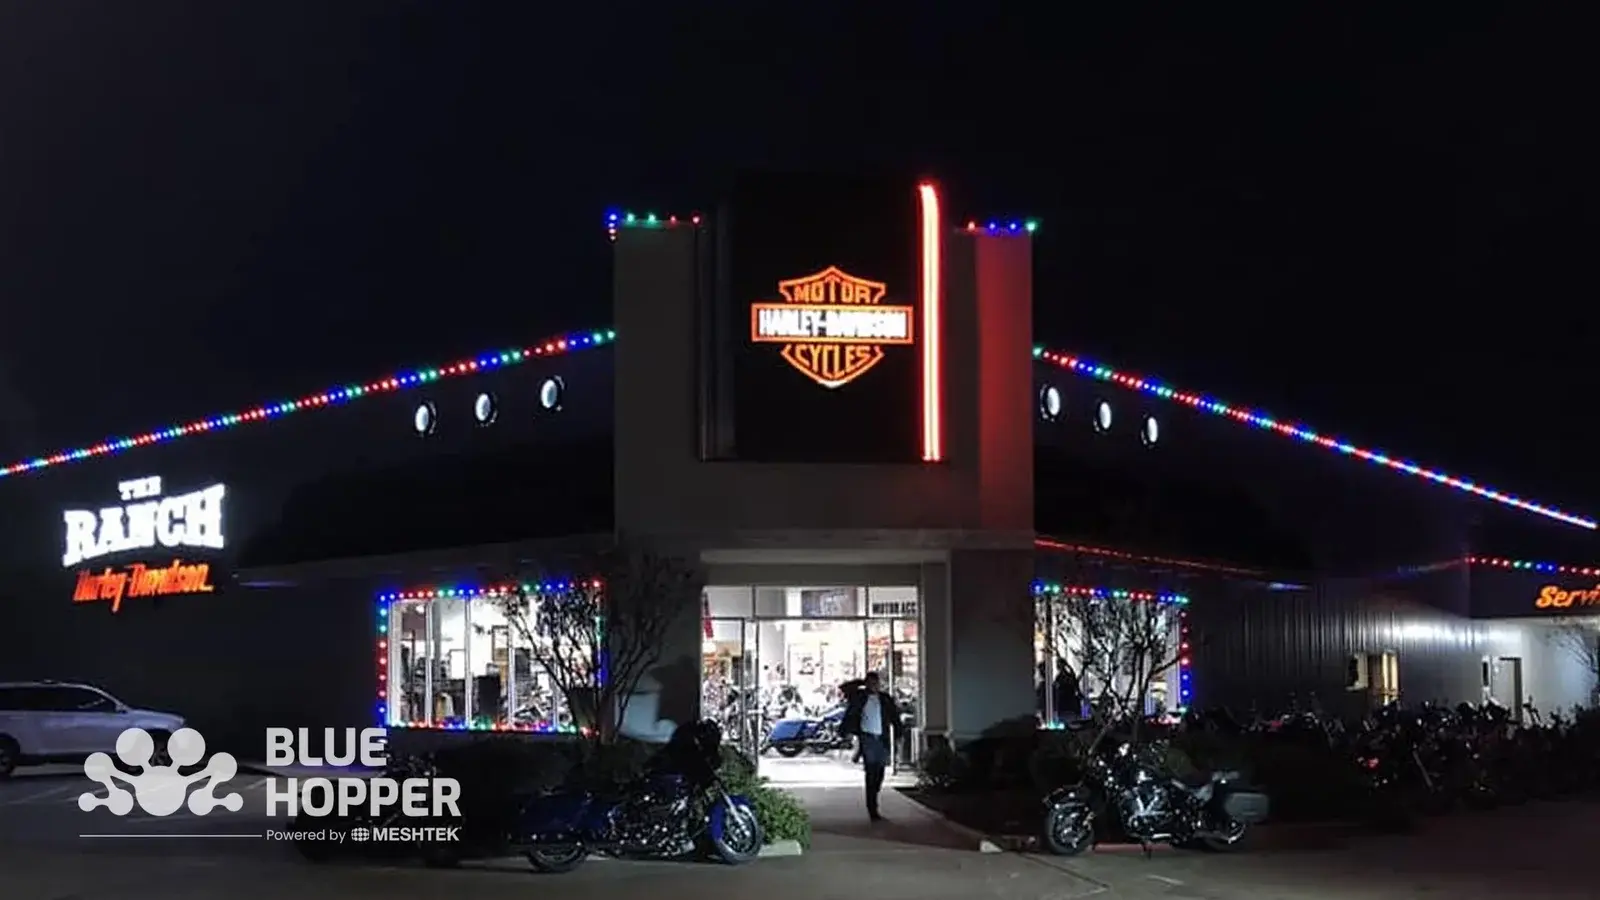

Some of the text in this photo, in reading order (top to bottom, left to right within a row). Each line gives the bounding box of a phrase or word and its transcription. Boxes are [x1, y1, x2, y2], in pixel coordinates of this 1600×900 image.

[794, 274, 871, 303] MOTOR
[758, 308, 907, 338] HARLEY-DAVIDSON
[794, 344, 871, 379] CYCLES
[118, 475, 161, 501] THE
[63, 483, 225, 567] RANCH
